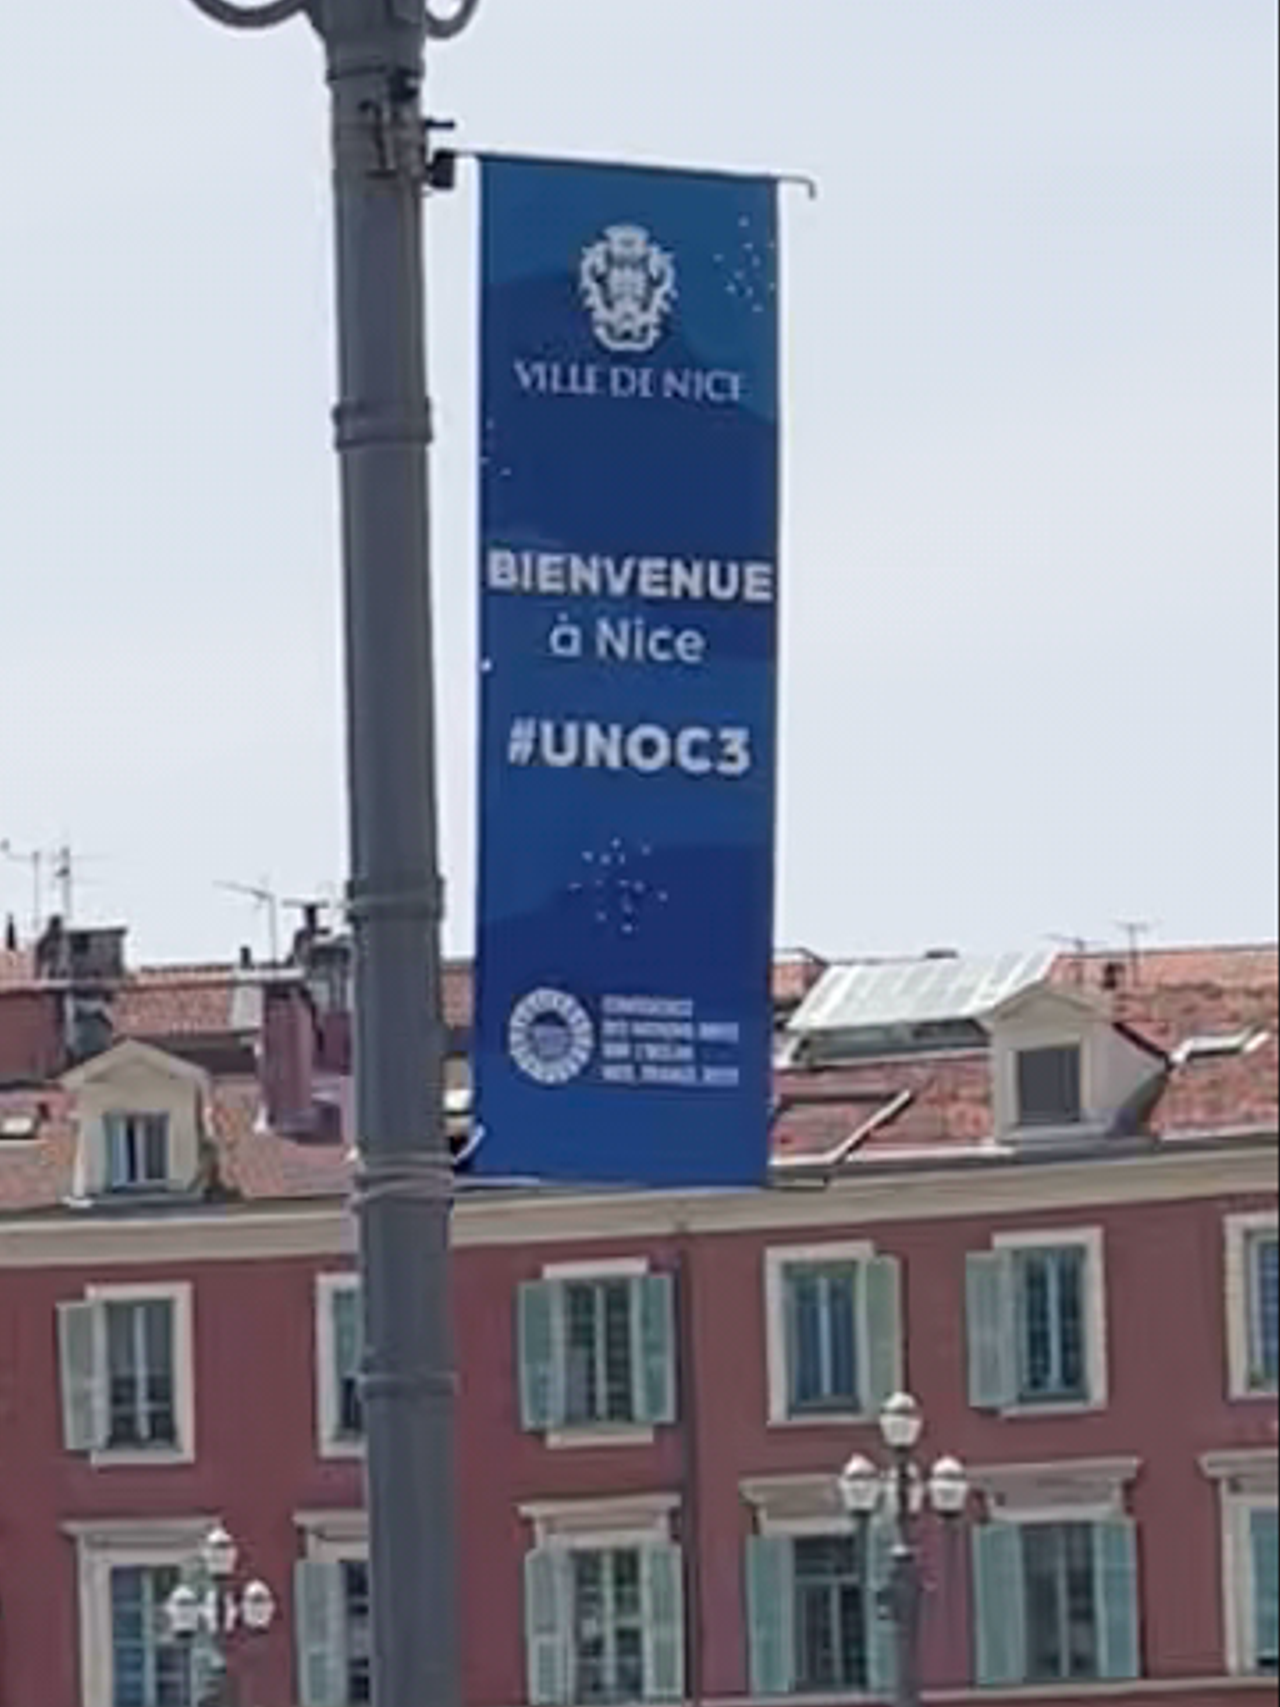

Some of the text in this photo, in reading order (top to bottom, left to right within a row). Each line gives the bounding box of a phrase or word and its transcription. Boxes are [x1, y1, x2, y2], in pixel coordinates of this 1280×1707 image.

[514, 359, 600, 394] VILLE
[662, 367, 744, 402] NICE
[488, 548, 773, 601] BIENVENUE
[595, 615, 705, 662] Nice
[509, 715, 750, 775] #UNOC3
